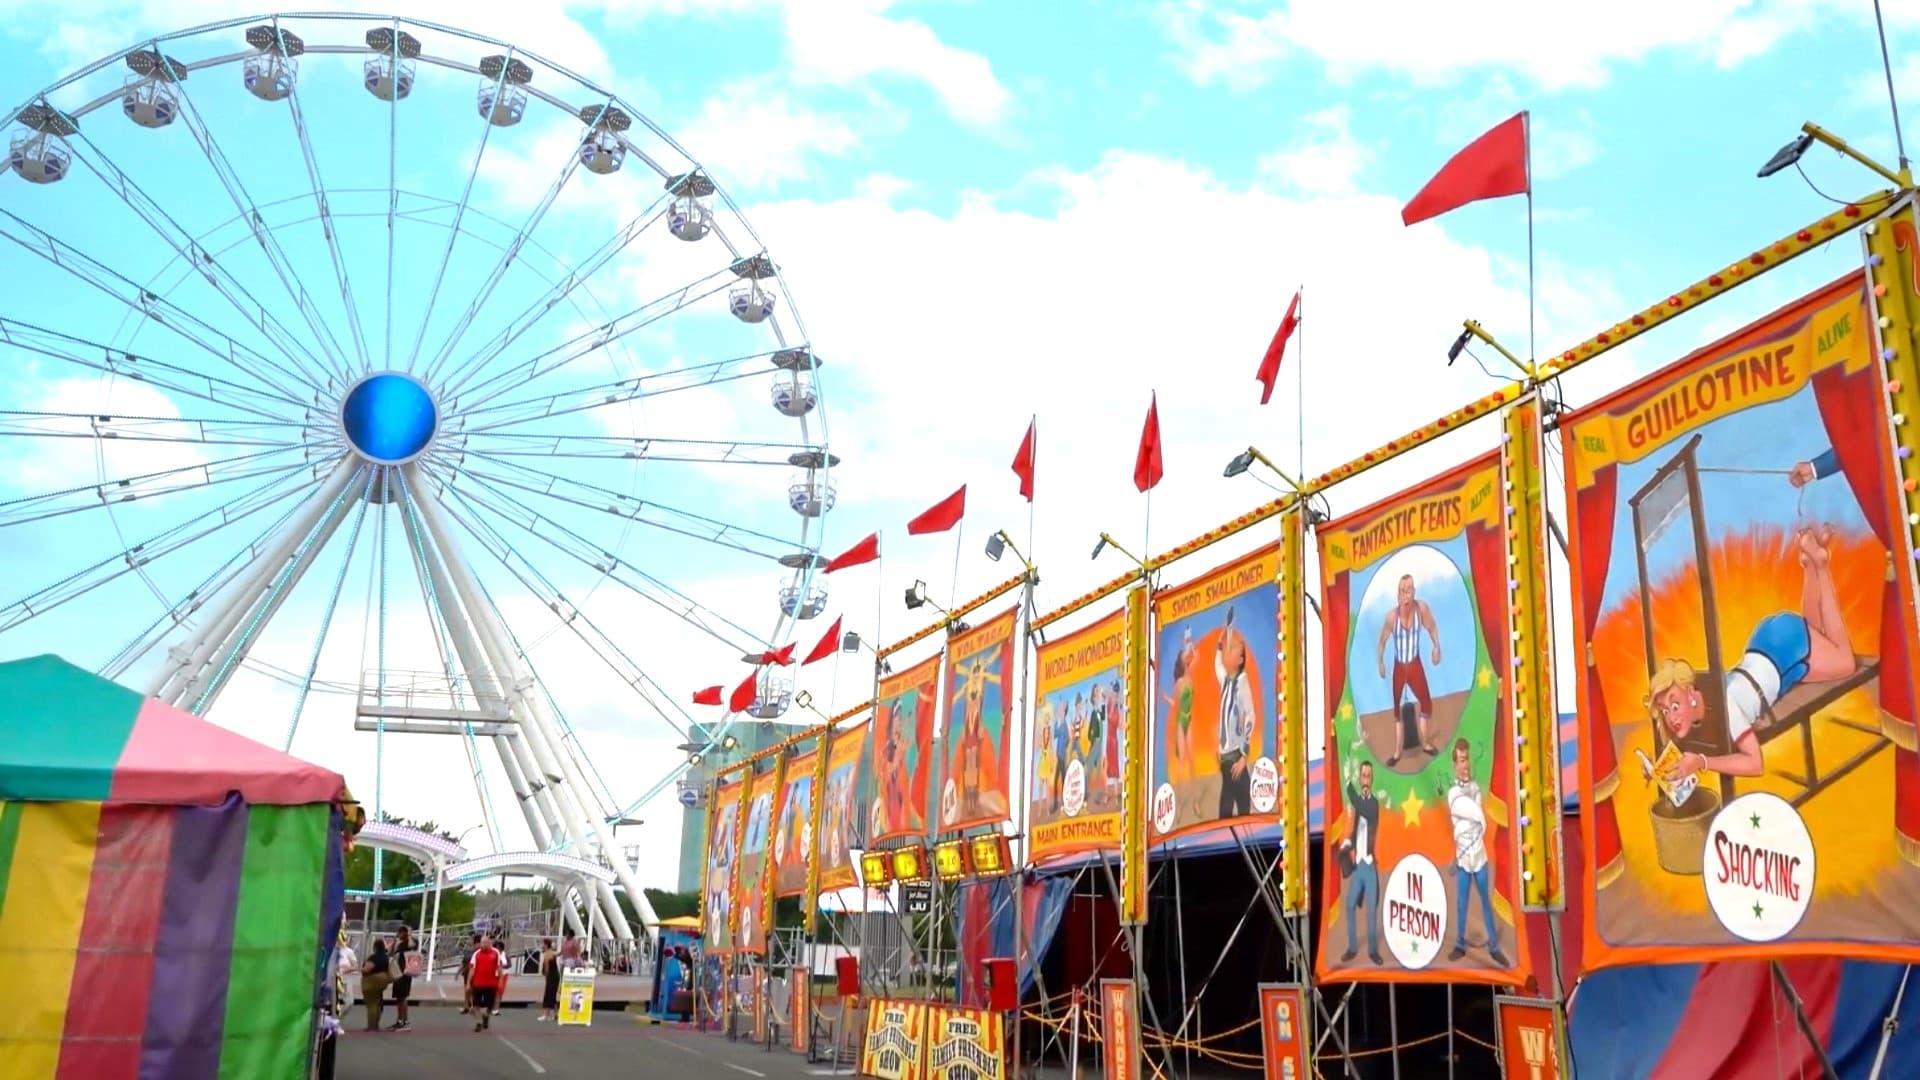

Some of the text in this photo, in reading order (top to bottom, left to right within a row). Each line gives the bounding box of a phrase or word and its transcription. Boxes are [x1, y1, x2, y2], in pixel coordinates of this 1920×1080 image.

[1817, 312, 1852, 356] ALIVE
[1626, 343, 1796, 449] GUILLOTINE
[1351, 495, 1462, 563] FANTASTIC FEATS
[1205, 564, 1264, 603] SWALLOWER
[1156, 793, 1173, 824] ALIVE
[1036, 817, 1114, 845] MAIN ENTRANCE
[1714, 830, 1801, 902] SHOCKING
[1406, 872, 1424, 903] IN
[1389, 899, 1440, 943] PERSON
[884, 1012, 905, 1024] FREE
[948, 1021, 978, 1035] FREE
[879, 1048, 901, 1073] SHOW
[932, 1037, 998, 1078] FAMILY FRIENDLY
